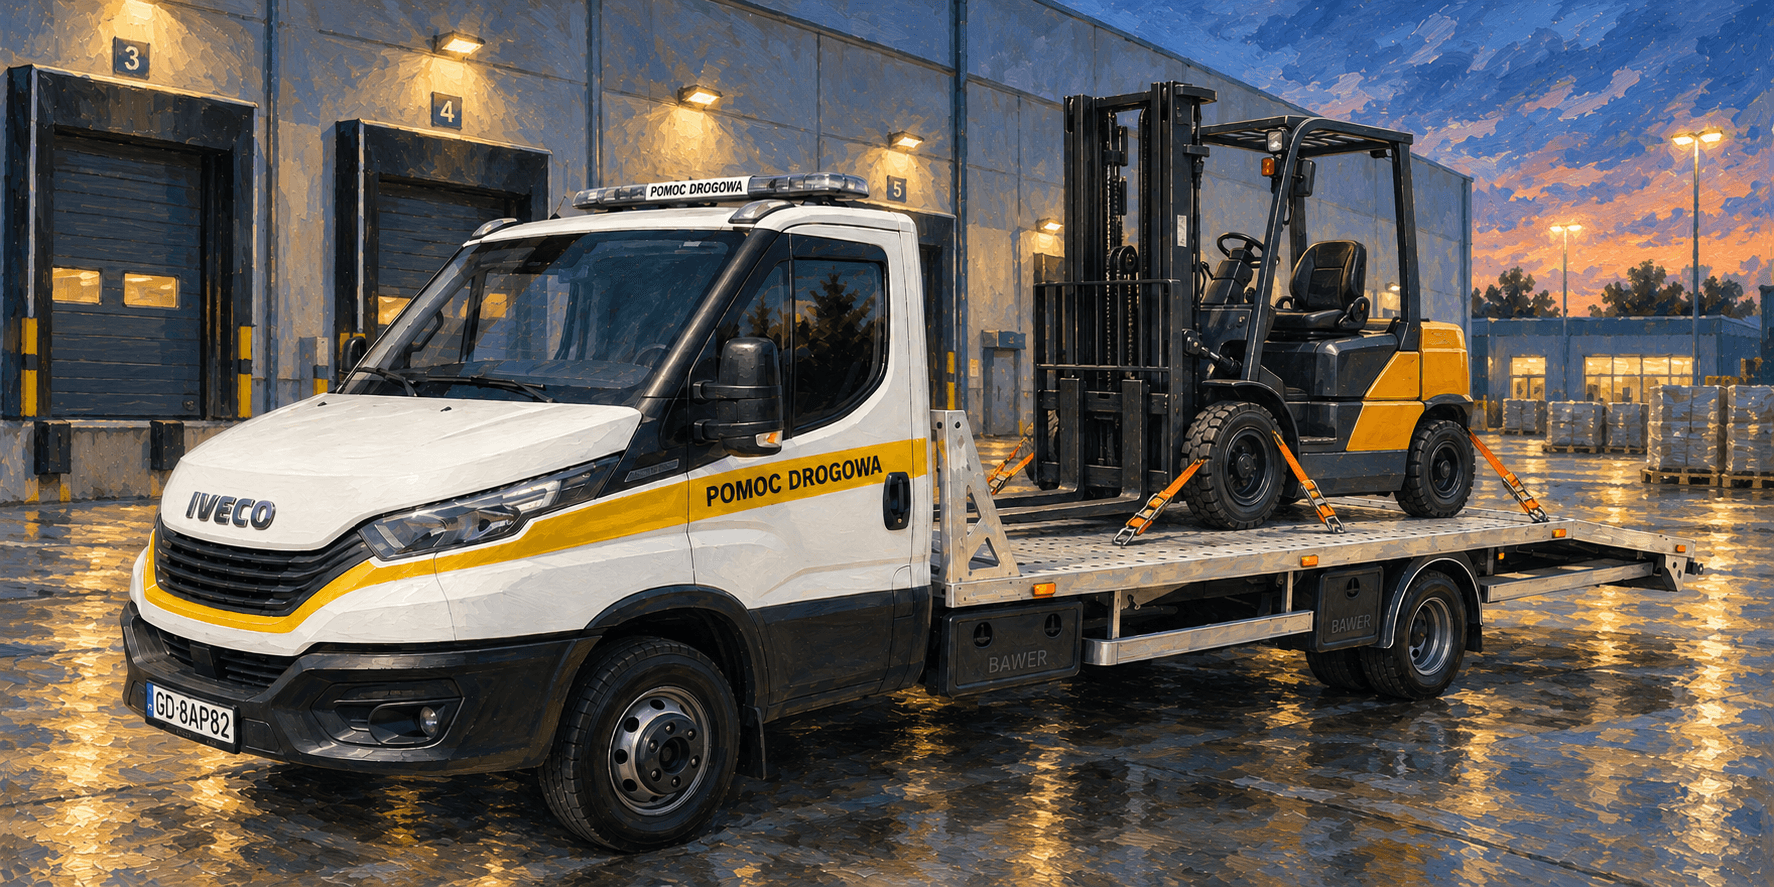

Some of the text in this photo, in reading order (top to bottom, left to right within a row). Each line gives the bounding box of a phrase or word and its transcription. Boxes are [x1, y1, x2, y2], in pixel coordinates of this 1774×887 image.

[124, 45, 140, 71] 3
[440, 100, 455, 123] 4
[650, 180, 743, 197] POMOC DROGOWA
[893, 180, 902, 198] 5
[706, 455, 883, 507] POMOC DROGOWA
[185, 491, 276, 531] IVECO
[1331, 614, 1371, 634] BAWER
[989, 649, 1047, 673] BAWER
